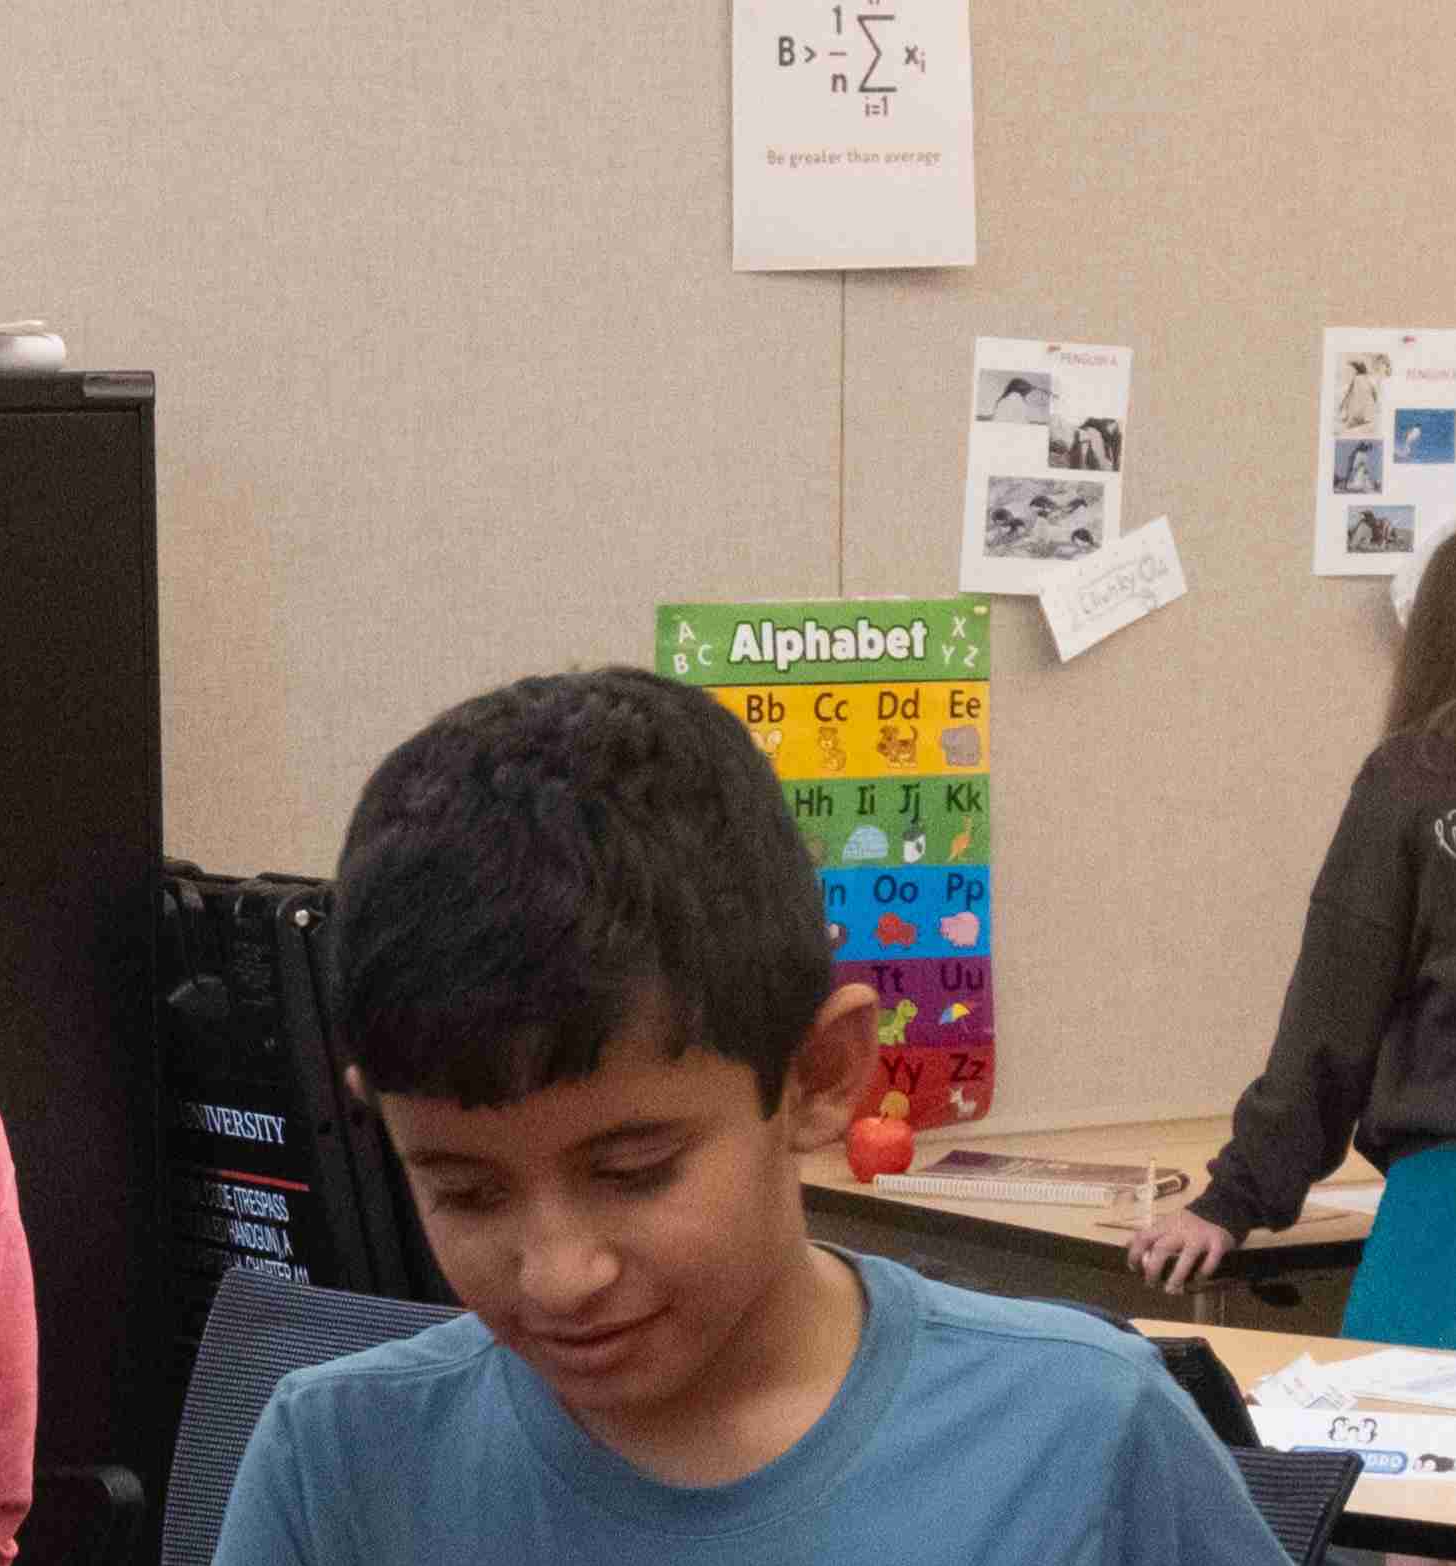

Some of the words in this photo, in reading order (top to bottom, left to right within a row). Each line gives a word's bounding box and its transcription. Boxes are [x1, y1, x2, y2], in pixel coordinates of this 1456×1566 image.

[766, 150, 784, 165] Be
[790, 150, 842, 168] greater
[846, 150, 881, 164] than
[885, 151, 942, 168] average
[678, 622, 695, 645] A
[952, 616, 966, 639] X
[697, 645, 713, 665] C
[728, 617, 928, 672] Alphabet
[941, 645, 955, 665] Y
[964, 647, 979, 667] Z
[673, 653, 689, 674] B
[746, 693, 785, 723] Bb
[814, 692, 848, 722] Cc
[878, 689, 919, 720] Dd
[950, 690, 981, 719] Ee
[796, 785, 833, 817] Hh
[899, 782, 920, 823] Jj
[946, 782, 982, 813] Kk
[874, 875, 918, 904] Oo
[946, 872, 984, 911] Pp
[872, 965, 903, 993] Tt
[940, 963, 983, 991] Uu
[881, 1054, 924, 1096] Yy
[949, 1053, 985, 1083] Zz
